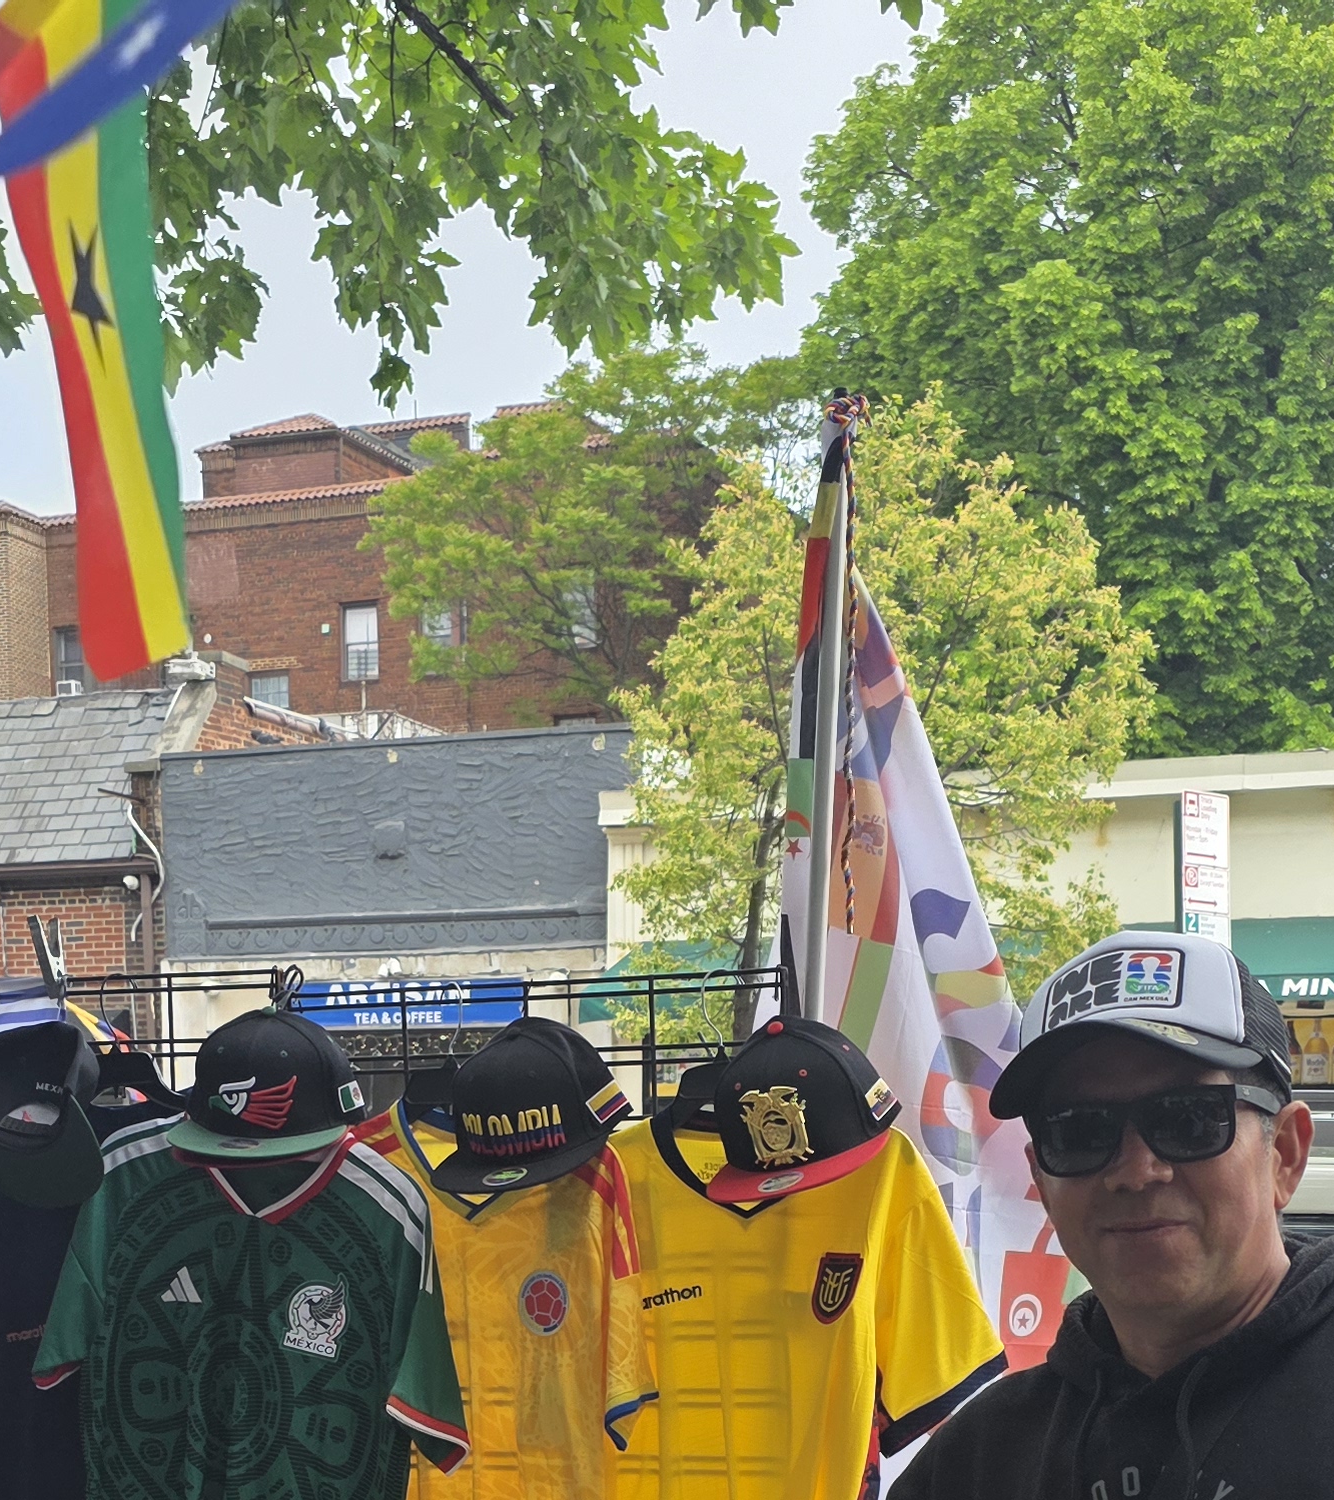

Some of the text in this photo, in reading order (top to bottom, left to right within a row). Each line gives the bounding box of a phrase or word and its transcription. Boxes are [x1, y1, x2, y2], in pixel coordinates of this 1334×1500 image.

[1188, 914, 1196, 932] 2
[1052, 952, 1124, 1006] WE
[1135, 984, 1160, 993] FIFA
[325, 980, 472, 1007] ARTISAN
[1048, 980, 1121, 1030] ARE
[354, 1010, 443, 1025] TEA & COFFEE
[285, 1332, 336, 1357] MÉXICO
